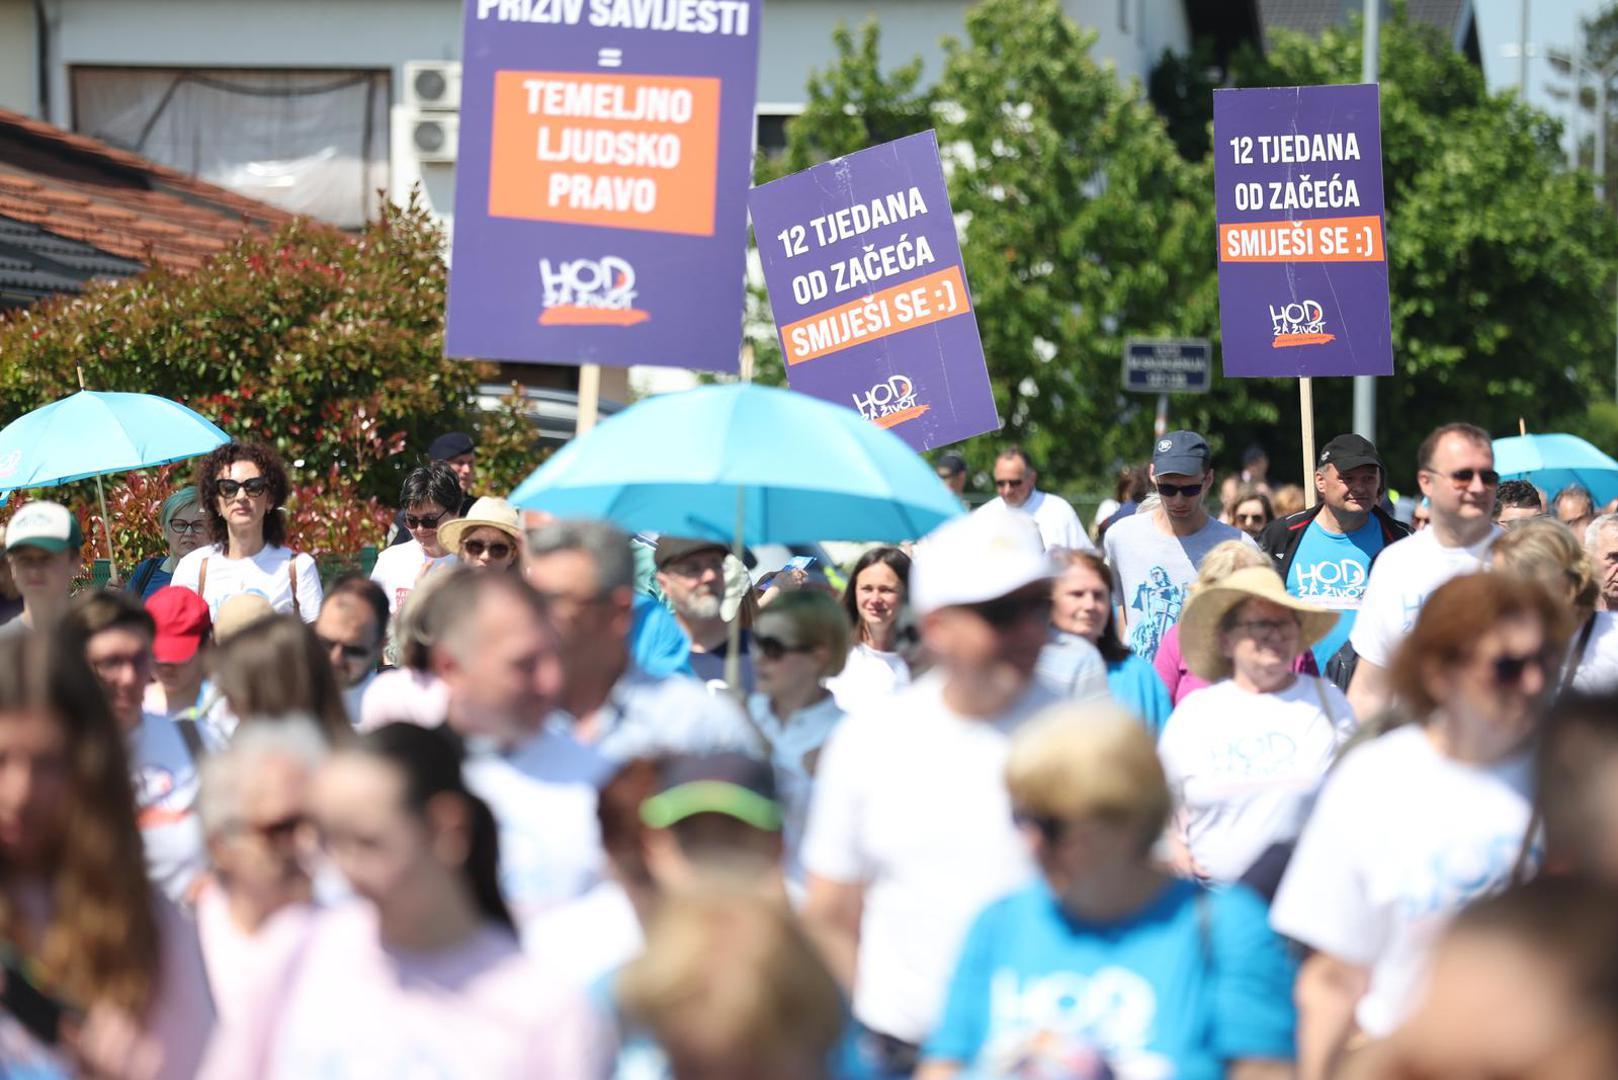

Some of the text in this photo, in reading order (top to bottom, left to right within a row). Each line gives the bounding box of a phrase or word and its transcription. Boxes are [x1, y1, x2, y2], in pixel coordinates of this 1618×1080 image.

[477, 0, 750, 36] PRIZIV SAVIJESTI
[524, 80, 693, 124] TEMELJNO
[537, 126, 681, 169] LJUDSKO
[1230, 132, 1361, 164] 12 TJEDANA
[548, 173, 657, 214] PRAVO
[1234, 173, 1361, 212] OD ZAČEĆA
[777, 186, 928, 258] 12 TJEDANA
[1227, 220, 1314, 258] SMIJEŠI
[1319, 226, 1349, 254] SE
[540, 255, 636, 302] HOD
[792, 233, 935, 306] OD ZAČEĆA
[791, 295, 891, 357] SMIJEŠI
[895, 287, 931, 323] SE
[1269, 299, 1323, 328] HOD
[1273, 321, 1327, 336] ZA ŽIVOT
[852, 374, 912, 415] HOD
[880, 393, 918, 417] ŽIVOT
[1295, 558, 1365, 587] HOD
[1297, 583, 1320, 600] ZA
